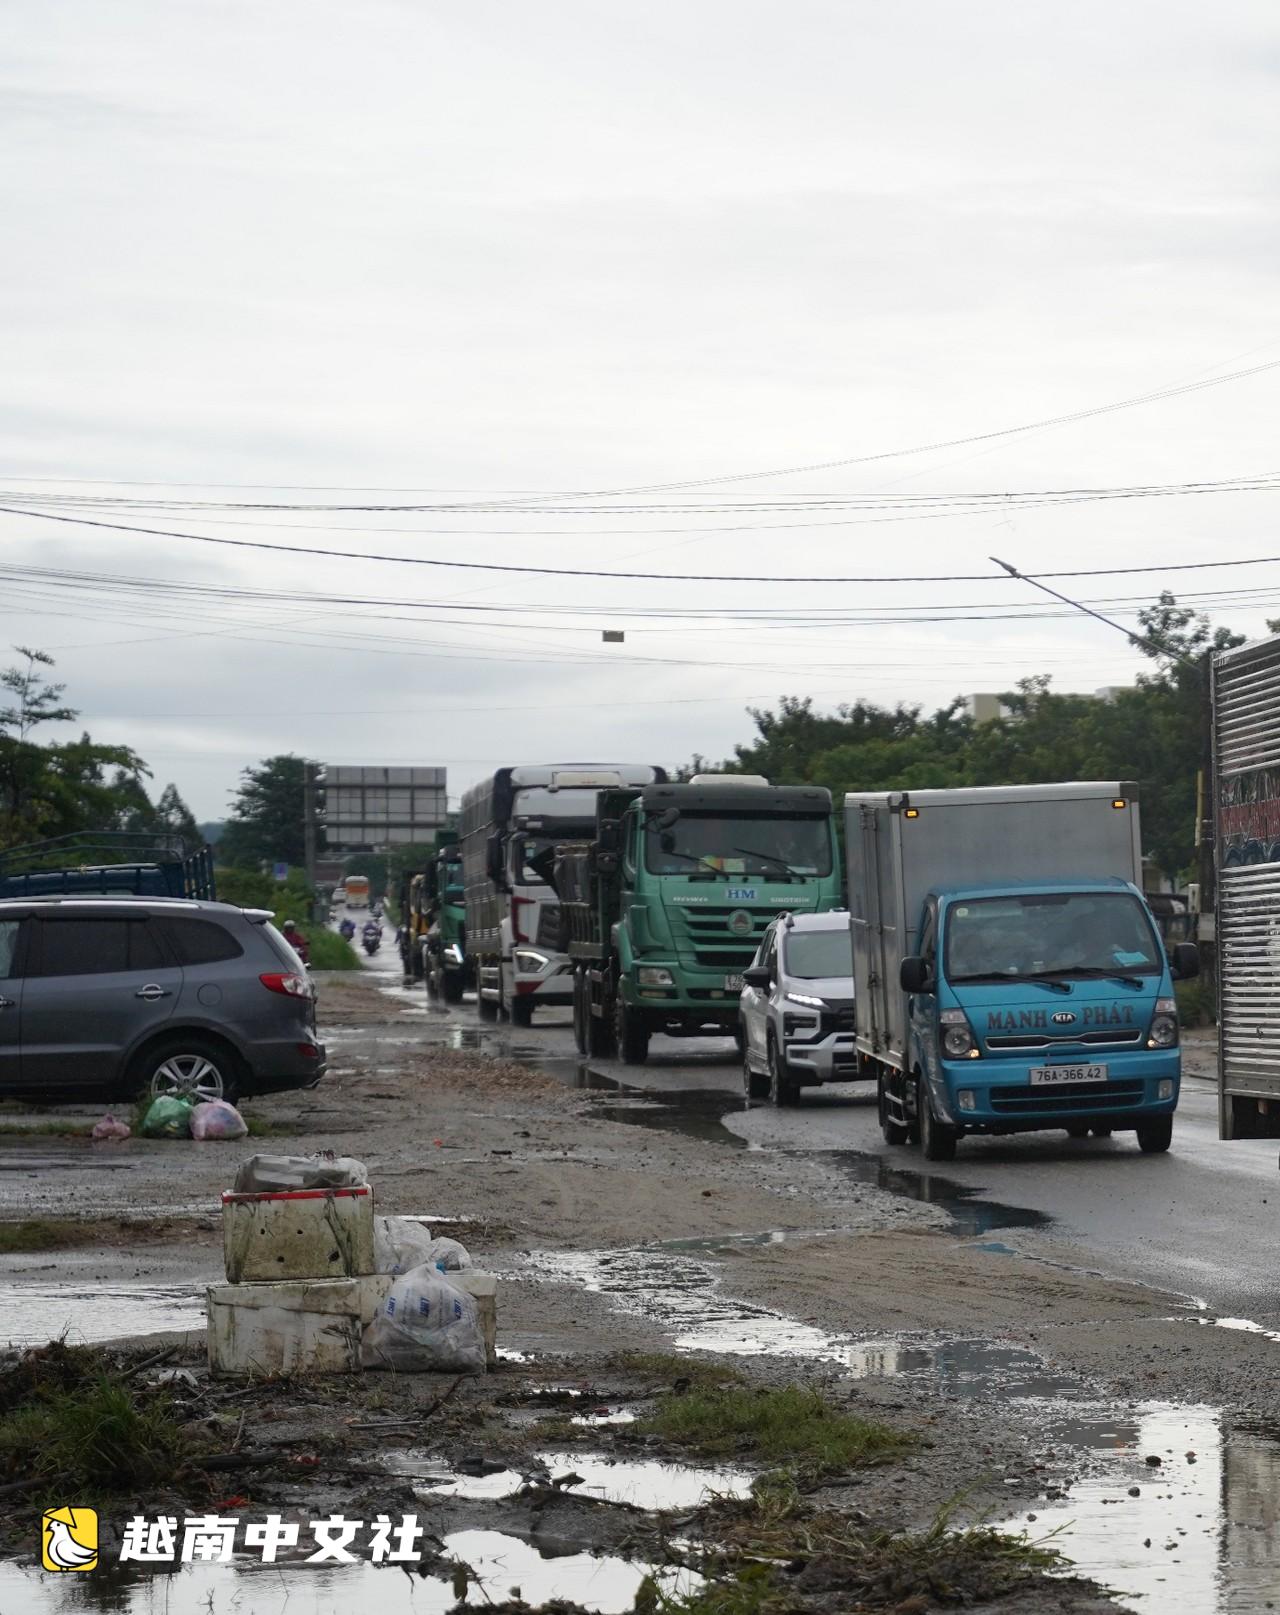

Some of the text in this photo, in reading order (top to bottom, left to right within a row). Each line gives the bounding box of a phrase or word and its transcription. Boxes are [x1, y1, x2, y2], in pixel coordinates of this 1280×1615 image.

[727, 889, 755, 899] HM
[988, 1001, 1134, 1034] MẠNH PHÁT
[1055, 1012, 1073, 1022] KIA
